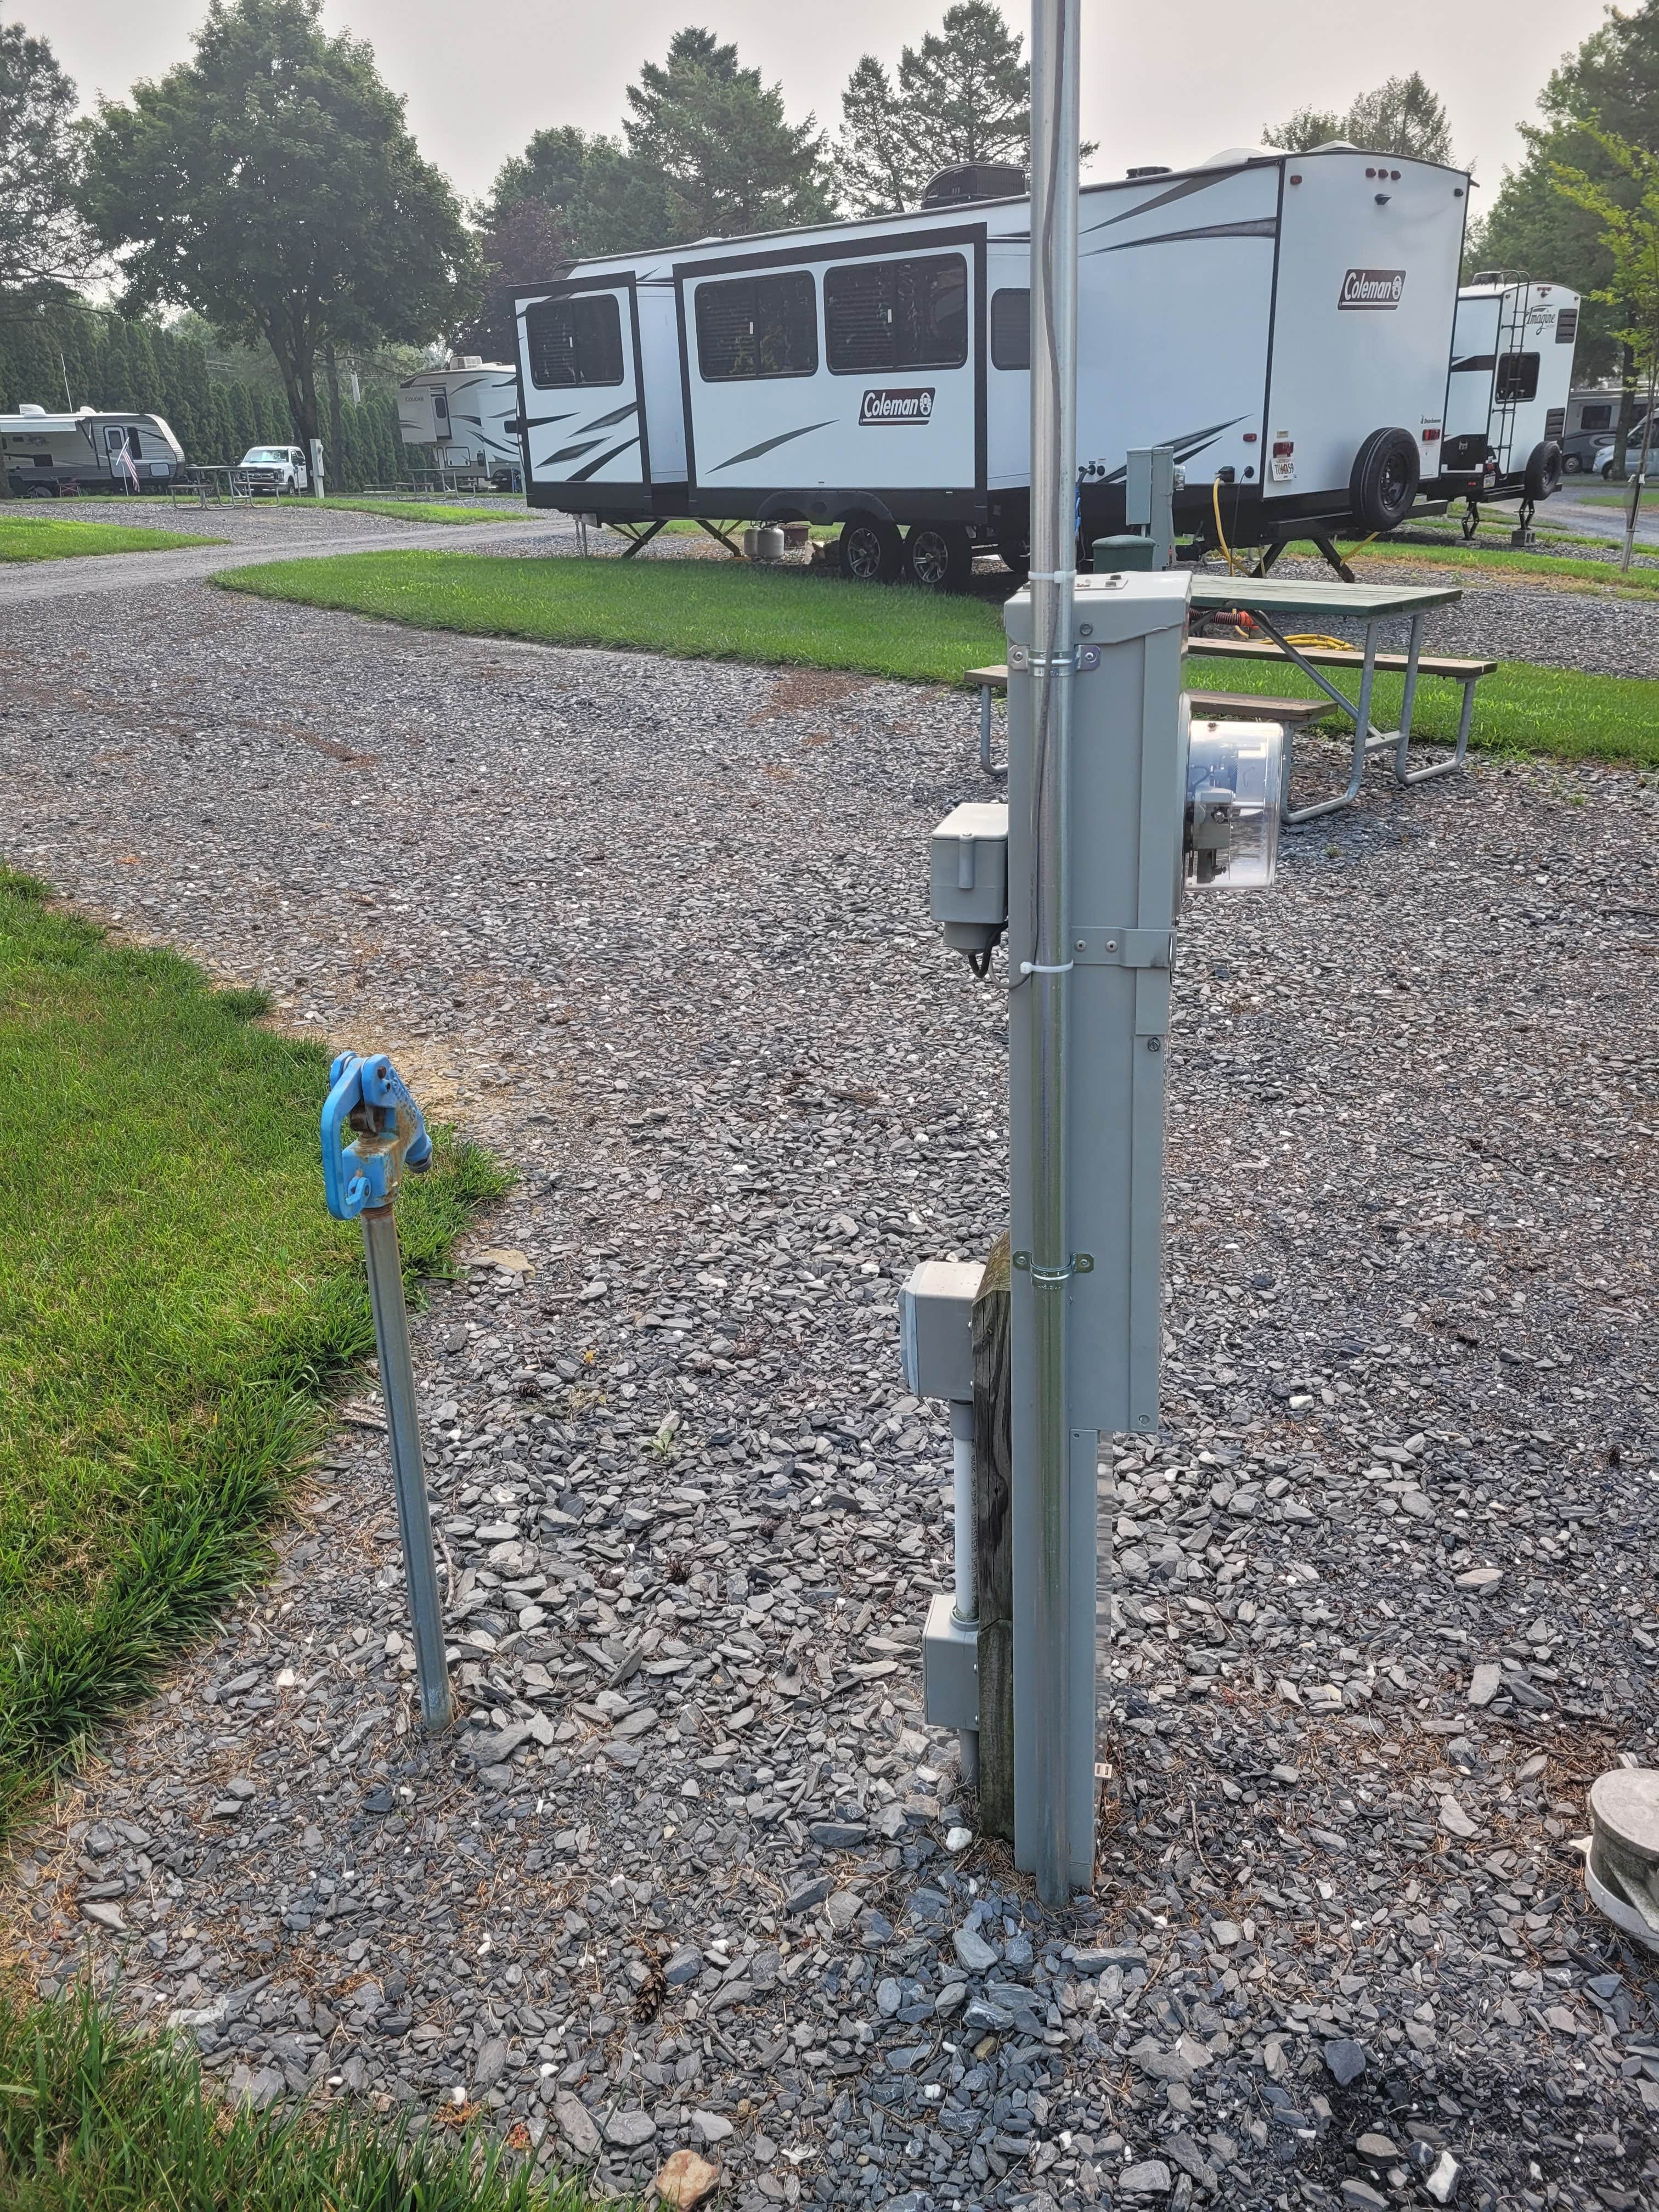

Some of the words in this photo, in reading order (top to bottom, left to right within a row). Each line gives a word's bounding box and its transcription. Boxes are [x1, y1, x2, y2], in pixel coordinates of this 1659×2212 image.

[1345, 272, 1391, 300] Coleman
[1525, 304, 1556, 335] Imagine
[864, 392, 919, 417] Coleman
